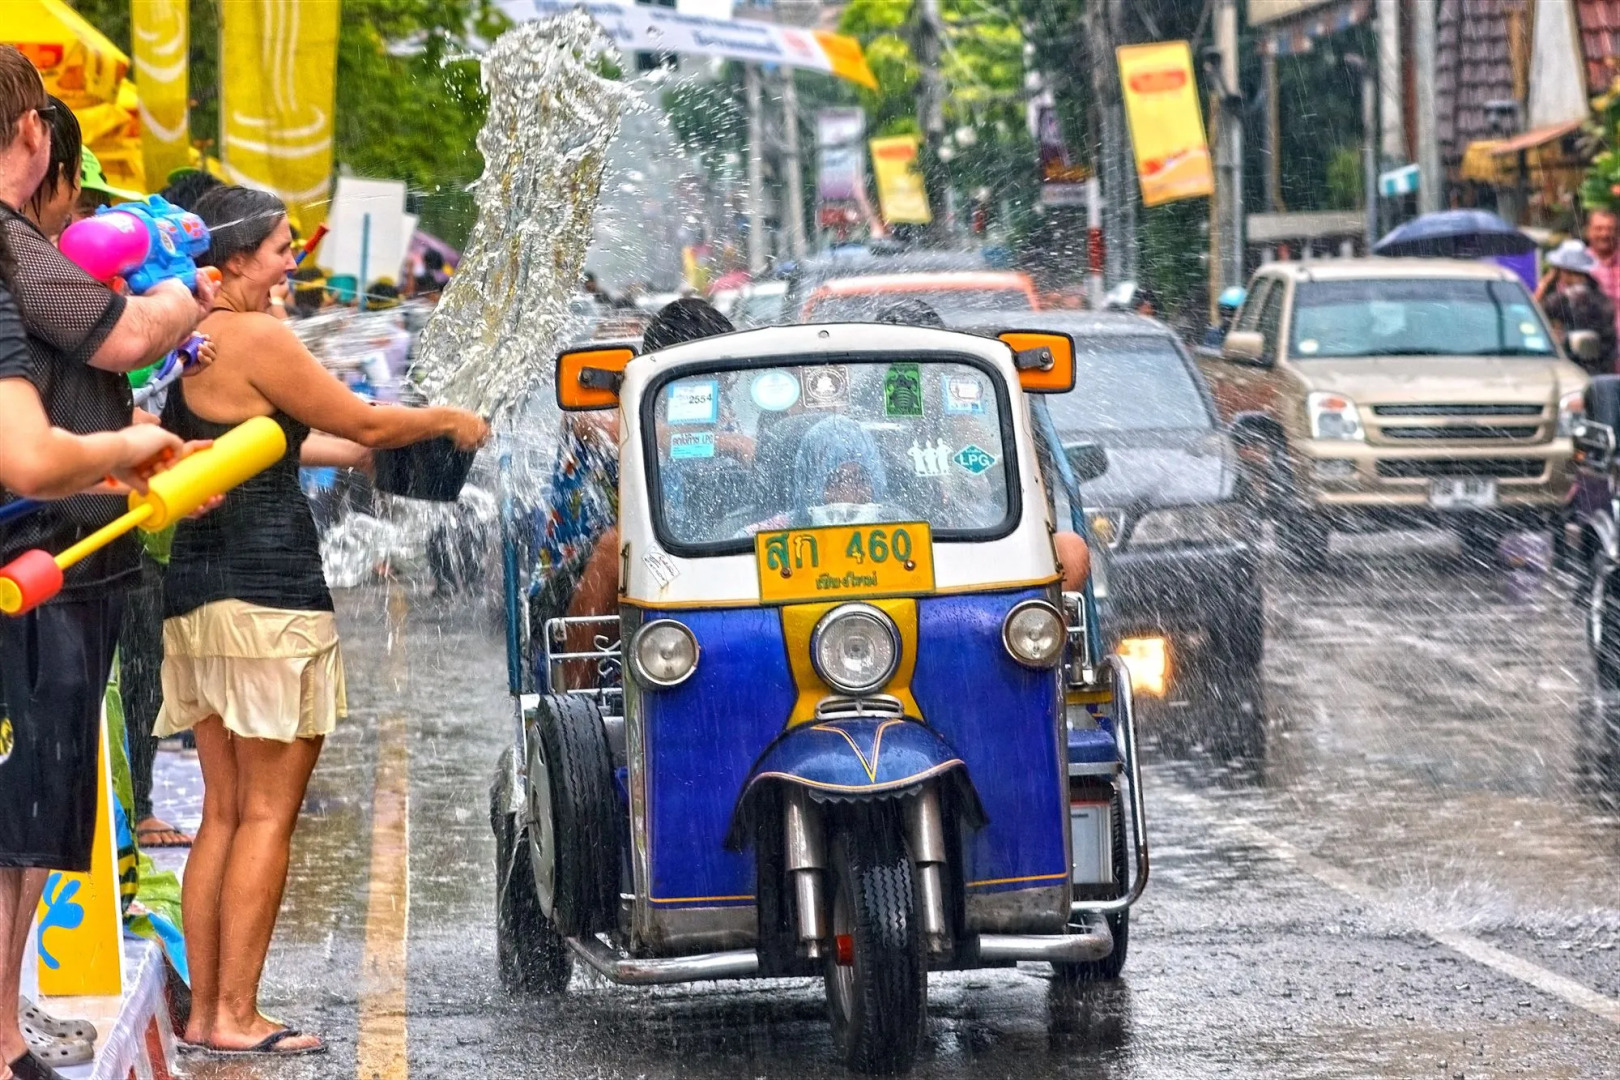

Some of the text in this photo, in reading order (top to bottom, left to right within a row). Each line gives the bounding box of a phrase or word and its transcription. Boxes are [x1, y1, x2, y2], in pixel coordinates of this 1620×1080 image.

[688, 393, 713, 405] 2554
[960, 453, 990, 467] LPG
[846, 528, 912, 564] 460
